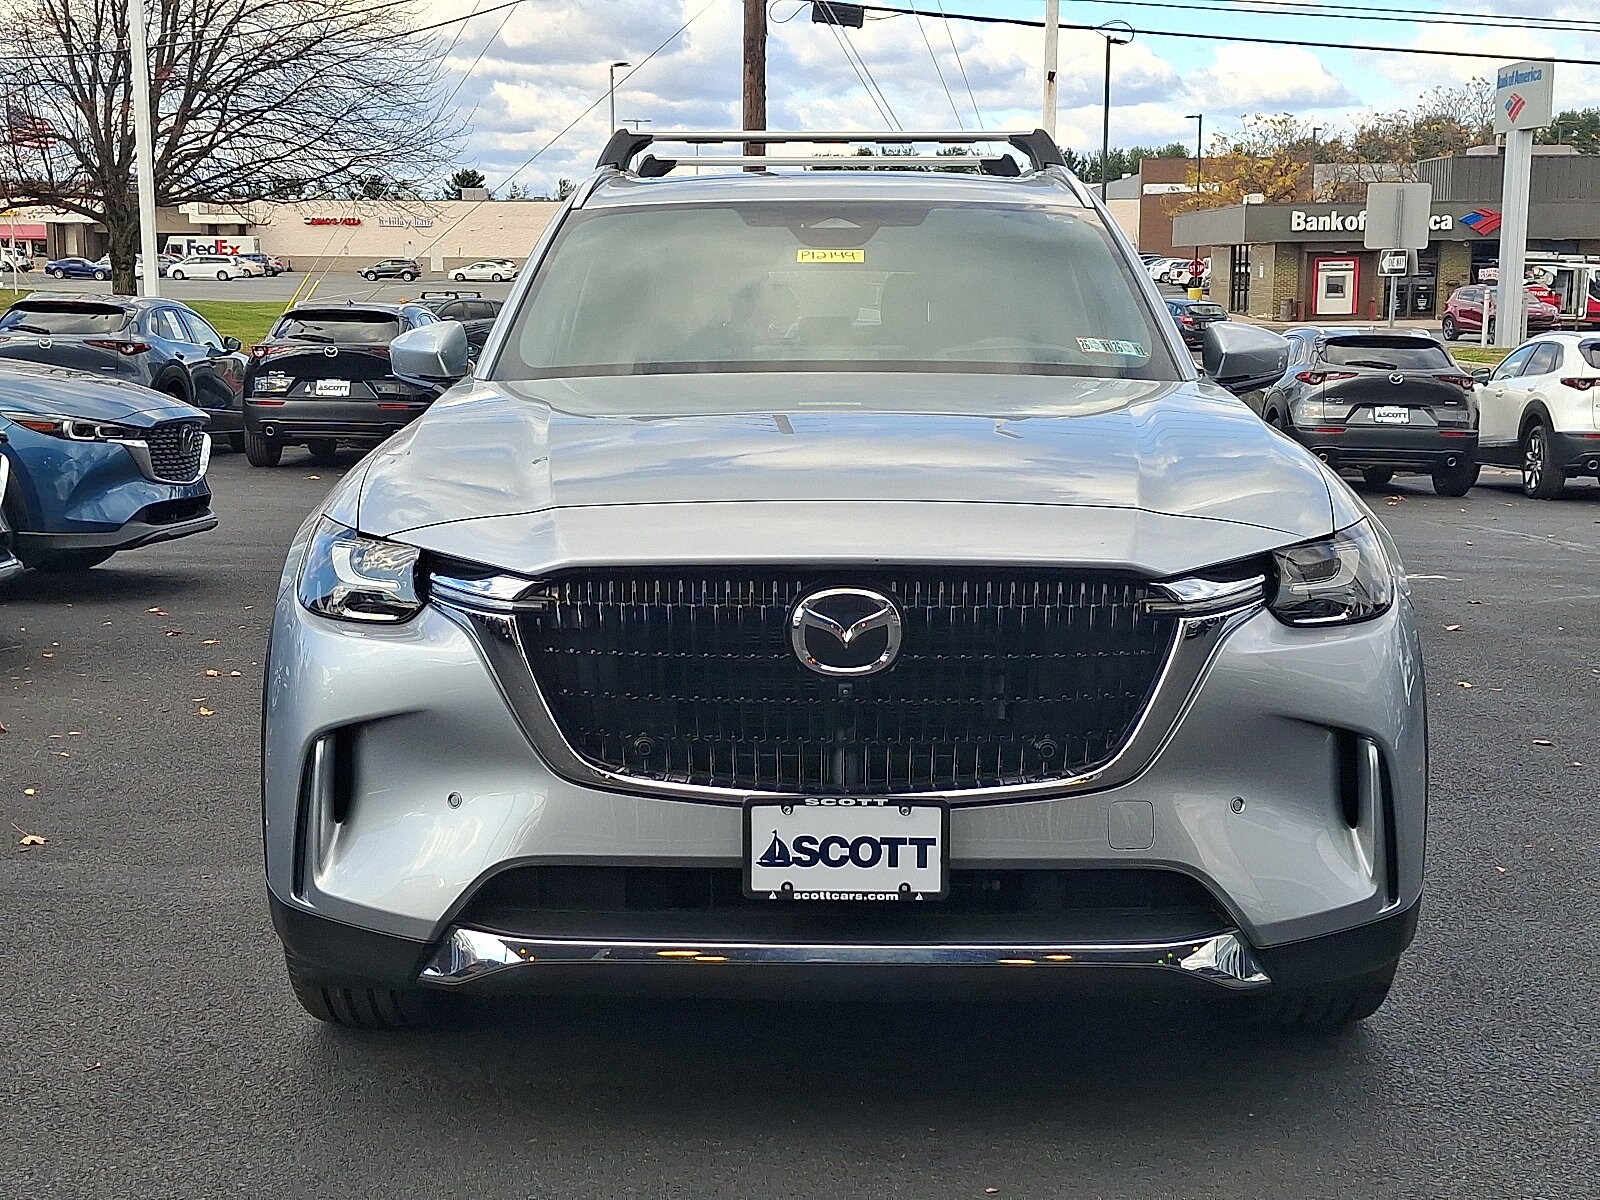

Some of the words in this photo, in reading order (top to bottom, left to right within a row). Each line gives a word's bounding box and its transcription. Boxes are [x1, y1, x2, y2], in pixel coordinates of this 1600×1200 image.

[1291, 210, 1343, 231] Bank
[1344, 211, 1368, 231] of
[186, 239, 240, 256] FedEx
[804, 798, 889, 806] SCOTT
[792, 835, 937, 868] SCOTT
[793, 891, 899, 901] scottcars.com
